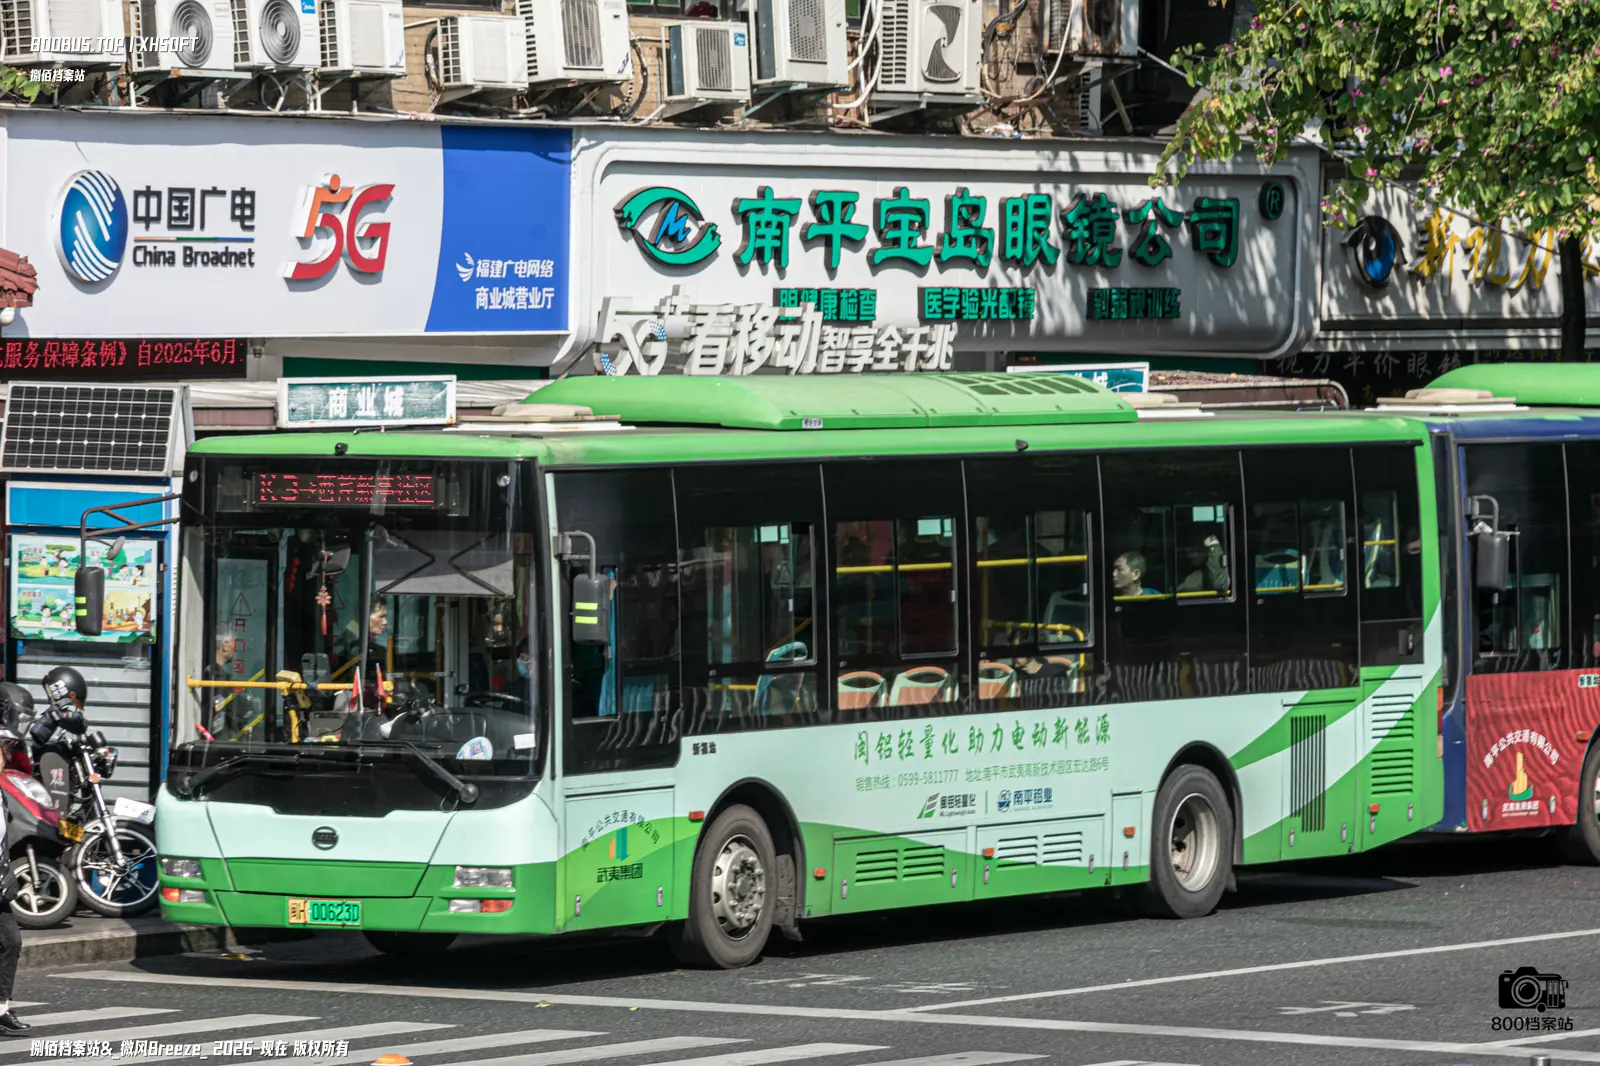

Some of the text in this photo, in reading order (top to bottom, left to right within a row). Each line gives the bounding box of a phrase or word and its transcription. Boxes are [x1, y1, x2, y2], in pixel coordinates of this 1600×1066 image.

[132, 185, 256, 232] 中国广电
[731, 185, 1240, 271] 南平宝岛眼镜公司
[132, 246, 256, 267] China Broadnet
[476, 259, 555, 278] 福建广电网络
[475, 286, 555, 310] 商业城营业厅
[922, 287, 1036, 320] 医学验光配镜
[328, 386, 404, 417] 商业城
[967, 712, 1112, 756] 助力电动新能源
[596, 862, 643, 884] 武夷集团
